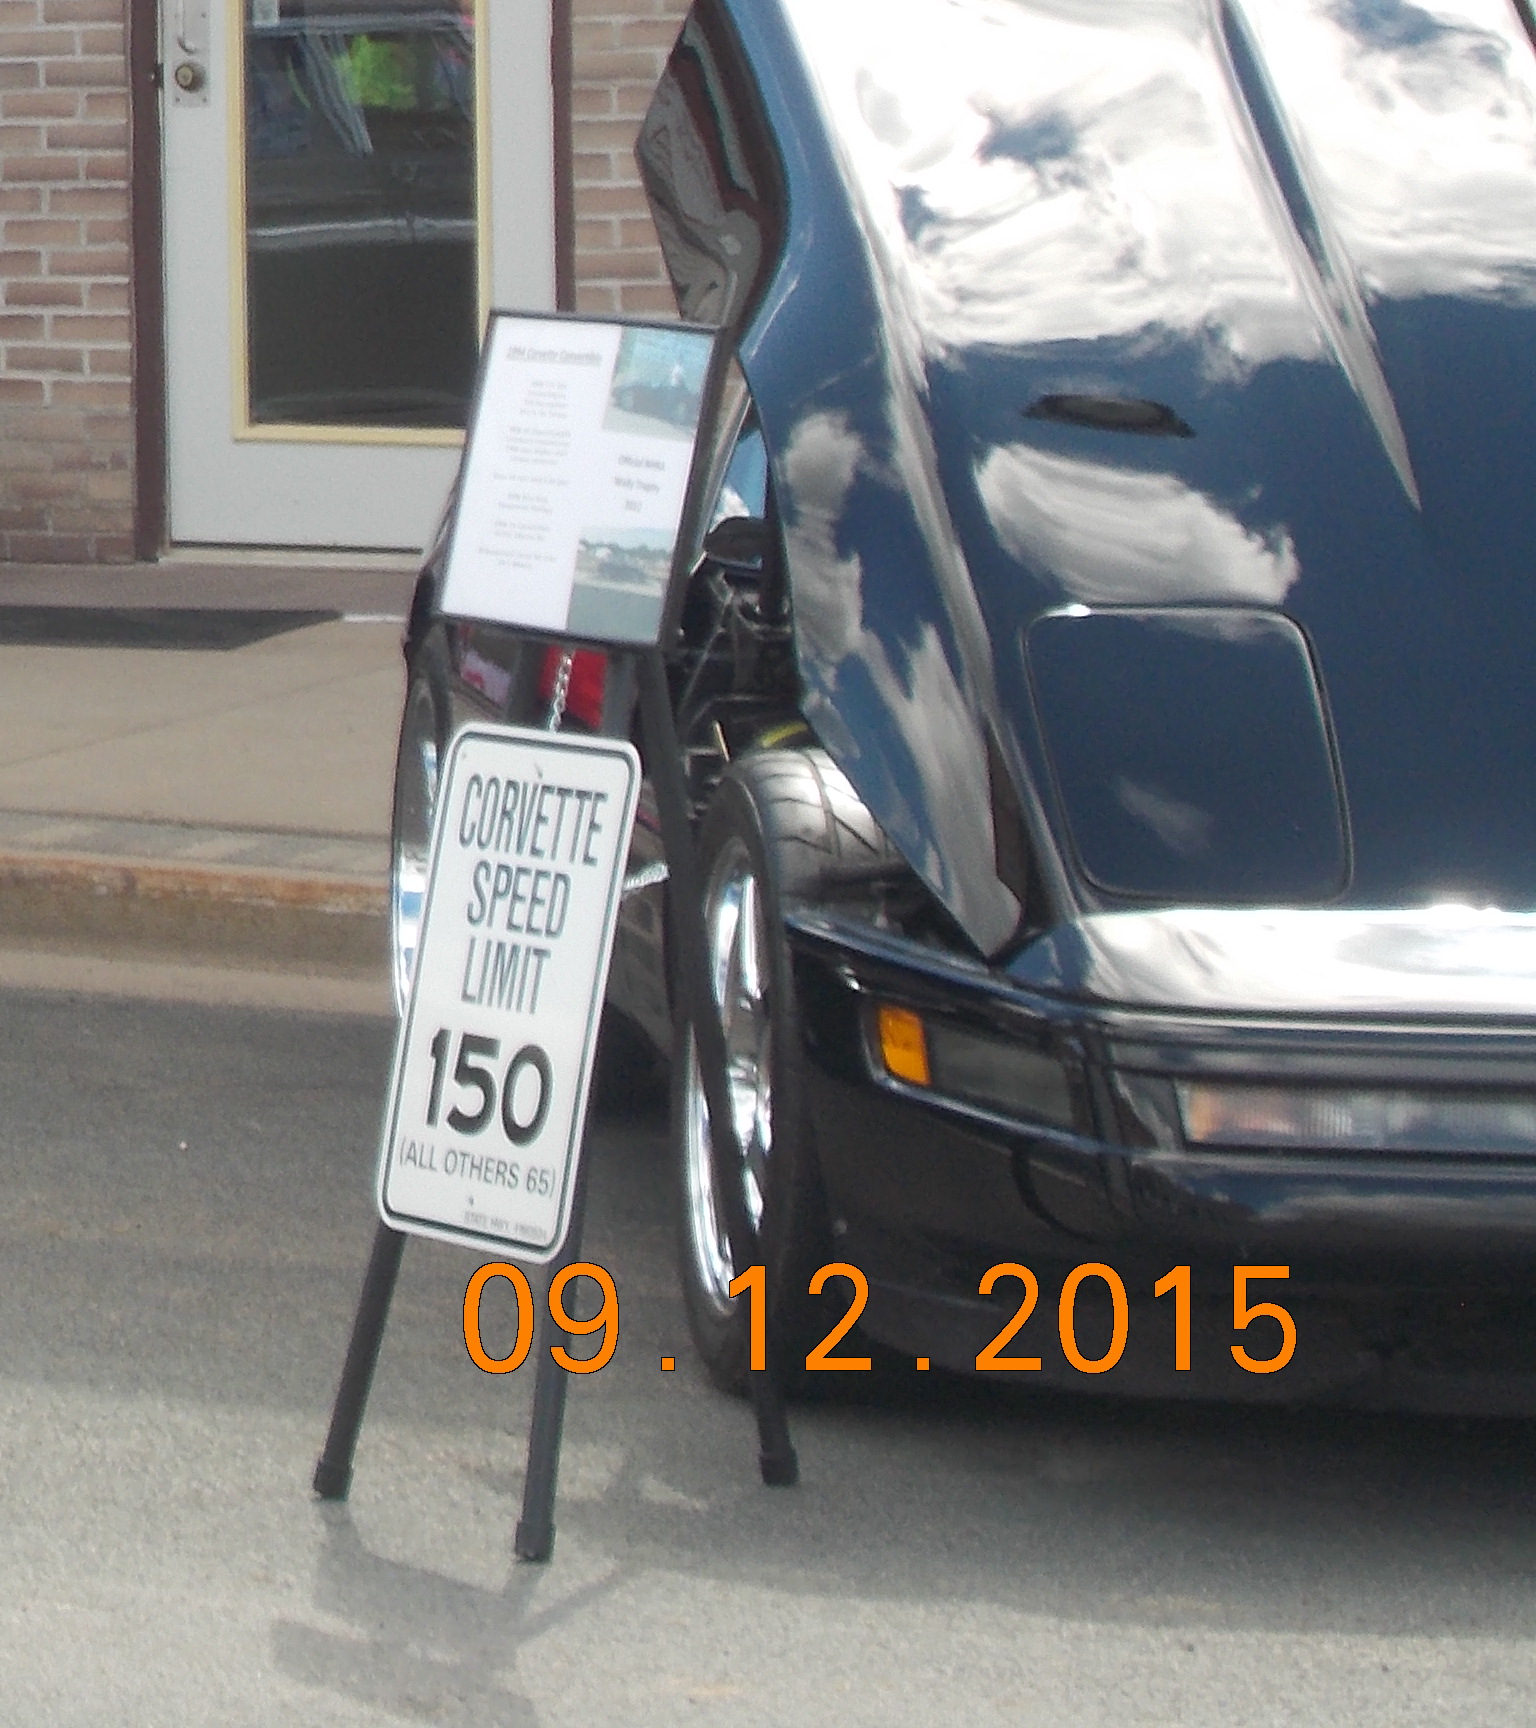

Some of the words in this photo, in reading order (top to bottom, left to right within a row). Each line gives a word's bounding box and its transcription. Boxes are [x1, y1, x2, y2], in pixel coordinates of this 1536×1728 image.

[457, 773, 609, 869] CORVETTE
[466, 861, 571, 939] SPEED
[461, 936, 551, 1015] LIMIT
[425, 1026, 554, 1148] 150
[398, 1135, 439, 1175] (ALL
[443, 1147, 520, 1191] OTHERS
[525, 1162, 557, 1200] 65)
